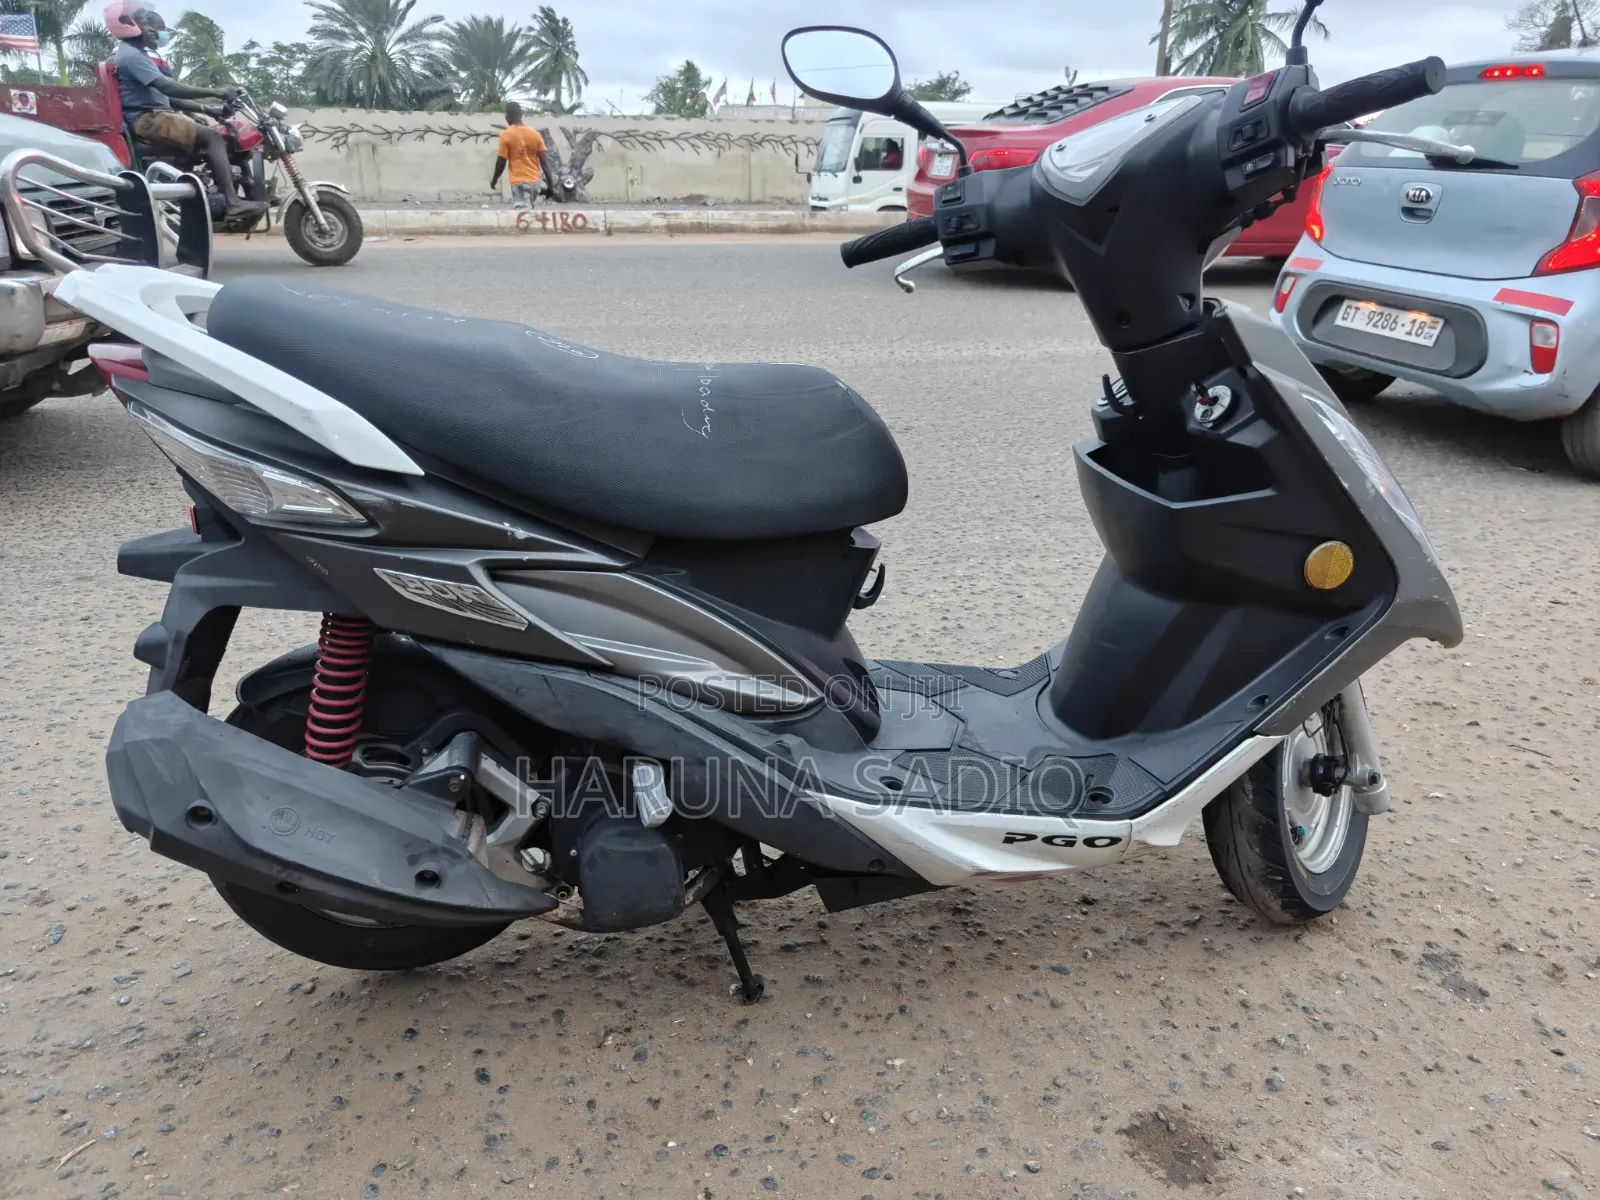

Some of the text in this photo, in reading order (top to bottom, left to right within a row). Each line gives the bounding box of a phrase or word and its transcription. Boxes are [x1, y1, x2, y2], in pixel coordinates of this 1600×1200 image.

[1407, 188, 1428, 202] KIA
[1341, 305, 1361, 323] GT
[1002, 831, 1123, 848] PGO
